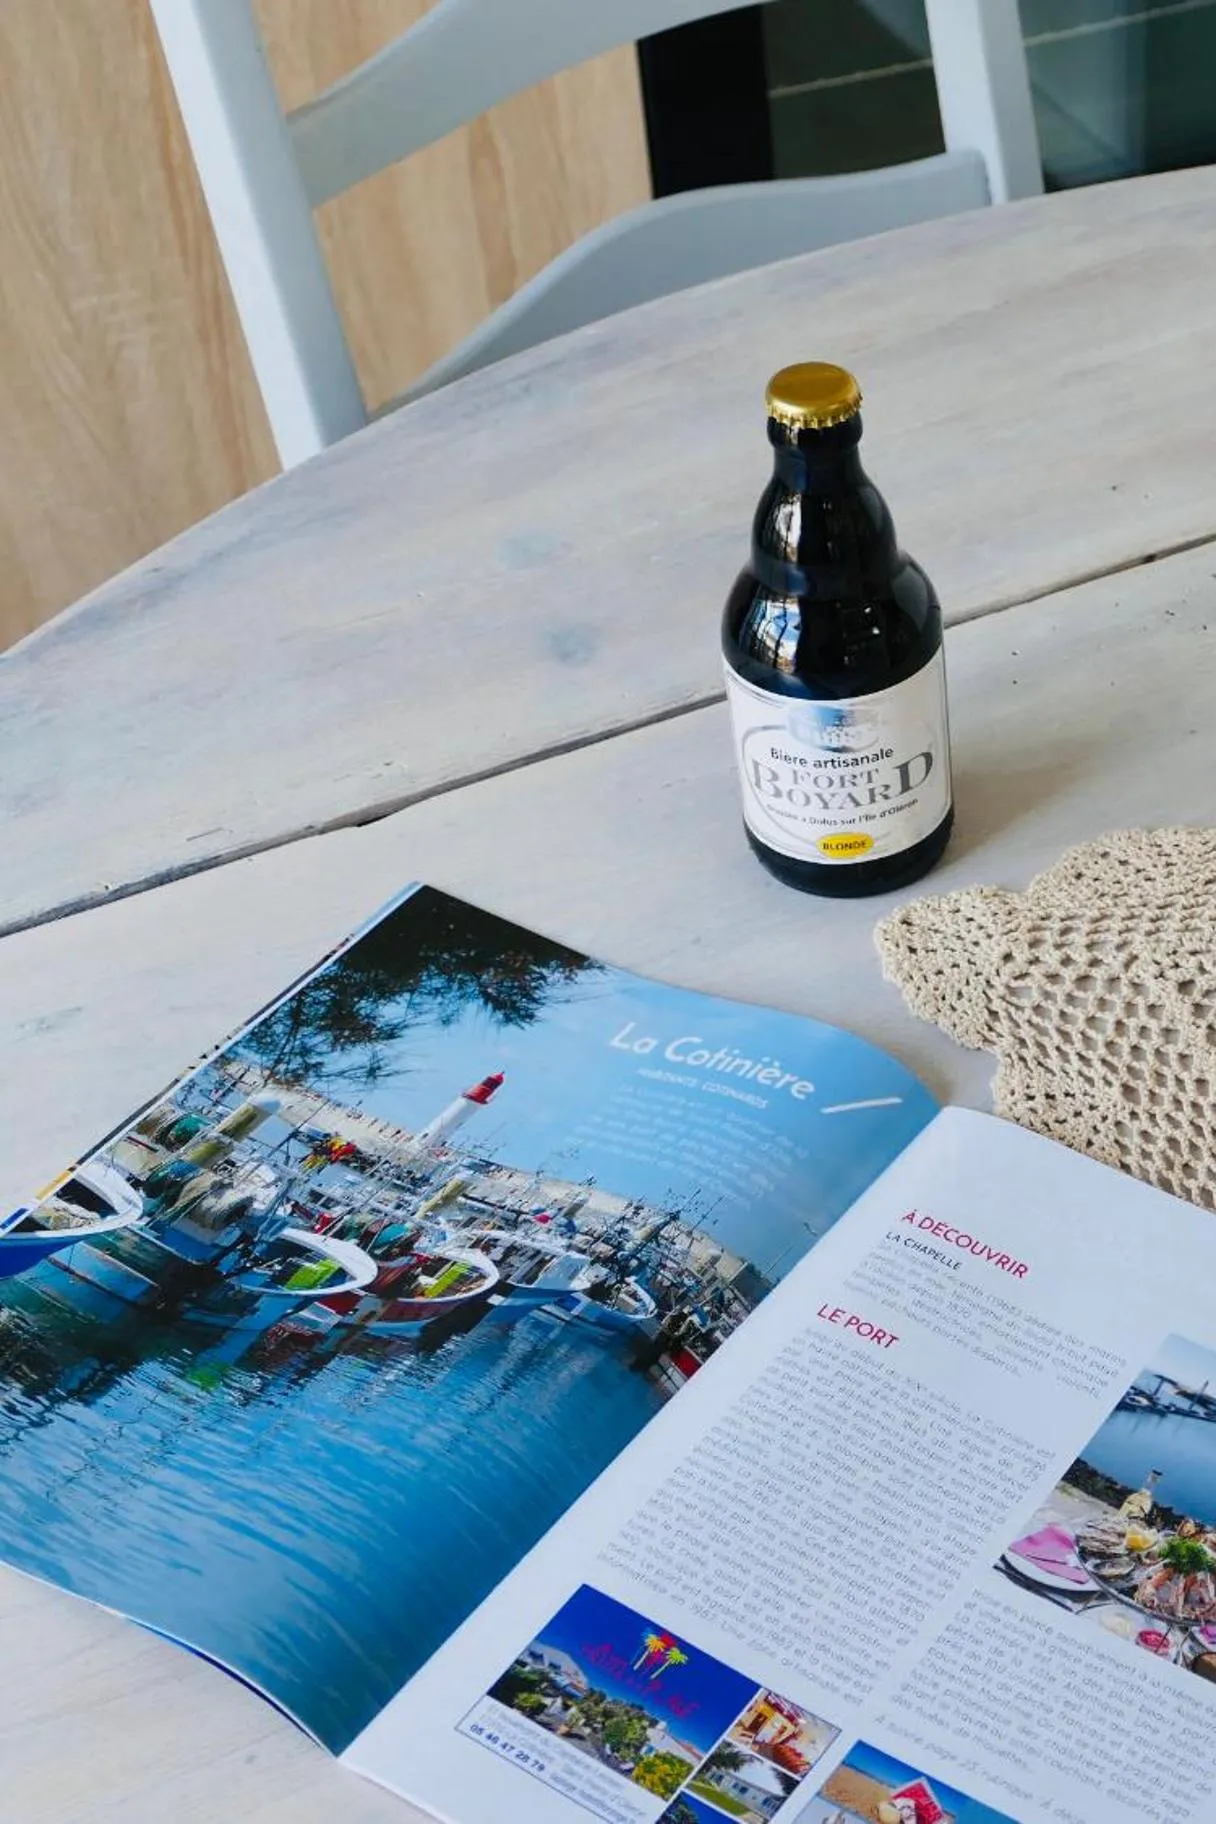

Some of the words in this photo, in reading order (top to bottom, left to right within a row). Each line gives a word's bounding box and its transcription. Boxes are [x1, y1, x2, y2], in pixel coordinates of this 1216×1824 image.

[770, 747, 808, 768] Bière
[813, 747, 895, 770] artisanale
[793, 767, 880, 790] FORT
[751, 751, 934, 811] BOYARD
[822, 838, 870, 851] BLONDE
[609, 1022, 659, 1054] La
[664, 1036, 816, 1101] Cotinière
[886, 1231, 902, 1243] LA
[904, 1237, 964, 1271] CHAPELLE
[901, 1208, 917, 1225] À
[917, 1215, 1029, 1279] DÉCOUVRIR
[817, 1303, 843, 1323] LE
[844, 1315, 901, 1350] PORT
[470, 1724, 483, 1737] 05
[485, 1732, 499, 1744] 46
[500, 1742, 515, 1755] 47
